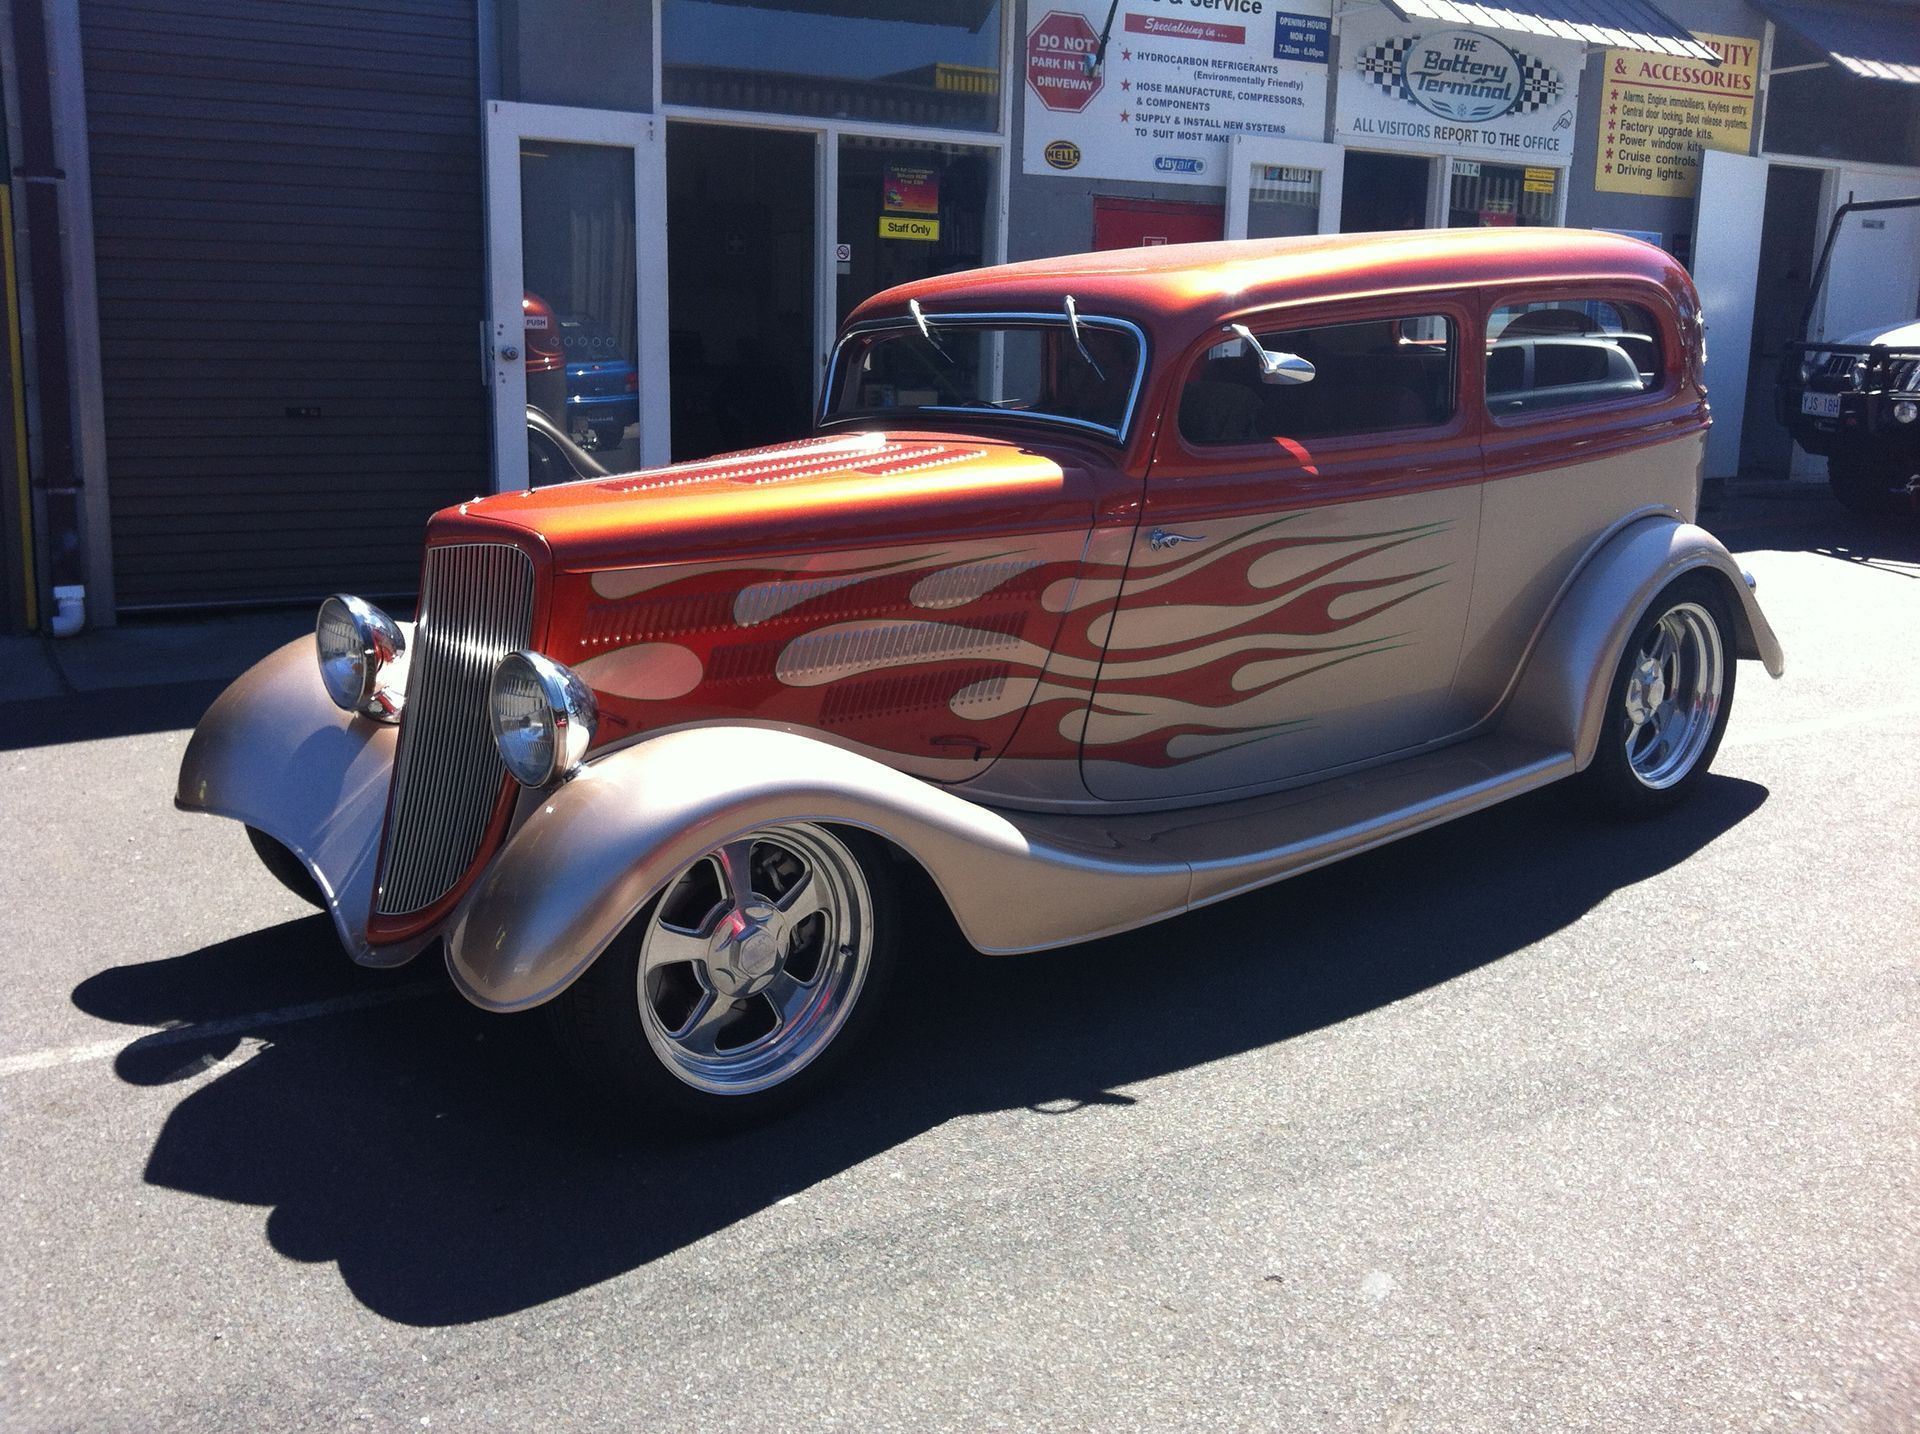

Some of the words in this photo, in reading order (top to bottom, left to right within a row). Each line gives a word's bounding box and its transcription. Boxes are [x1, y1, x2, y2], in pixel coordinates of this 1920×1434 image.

[1144, 18, 1204, 38] Specialising
[1279, 17, 1306, 28] OPENING
[1306, 20, 1327, 31] HOURS
[1039, 34, 1060, 48] DO
[1063, 36, 1094, 52] NOT
[1289, 31, 1304, 41] MON
[1454, 37, 1480, 52] THE
[1031, 56, 1061, 69] PARK
[1063, 60, 1076, 71] IN
[1137, 52, 1209, 68] HYDROCARBON
[1211, 60, 1279, 75] REFRIGERANTS
[1424, 50, 1508, 83] Battery
[1193, 70, 1266, 87] (Environmentally
[1267, 78, 1304, 91] Friendly)
[1614, 57, 1627, 75] &
[1639, 62, 1752, 90] ACCESSORIES
[1037, 76, 1094, 91] DRIVEWAY
[1410, 71, 1512, 101] Terminal
[1136, 82, 1162, 93] HOSE
[1164, 85, 1235, 101] MANUFACTURE,
[1237, 91, 1305, 108] COMPRESSORS,
[1136, 97, 1143, 106] &
[1146, 98, 1210, 111] COMPONENTS
[1648, 93, 1667, 107] Engine
[1707, 101, 1730, 115] Keyless
[1135, 113, 1171, 124] SUPPLY
[1174, 116, 1181, 125] &
[1183, 117, 1221, 128] INSTALL
[1223, 120, 1244, 130] NEW
[1245, 122, 1286, 134] SYSTEMS
[1621, 105, 1643, 118] Central
[1645, 107, 1660, 119] door
[1686, 112, 1700, 124] Boot
[1701, 115, 1722, 127] release
[1135, 128, 1148, 137] TO
[1152, 129, 1174, 139] SUIT
[1177, 131, 1202, 141] MOST
[1353, 117, 1374, 133] ALL
[1378, 120, 1430, 138] VISITORS
[1434, 126, 1479, 143] REPORT
[1482, 131, 1496, 145] TO
[1500, 132, 1520, 147] THE
[1523, 135, 1560, 151] OFFICE
[1620, 119, 1654, 136] Factory
[1657, 126, 1693, 139] upgrade
[1696, 129, 1713, 140] kits.
[1619, 133, 1647, 147] Power
[1651, 138, 1684, 151] window
[1047, 150, 1081, 162] HELLA
[1618, 149, 1651, 163] Cruise
[1655, 154, 1699, 168] controls.
[1617, 163, 1652, 180] Driving
[1656, 166, 1686, 181] lights.
[887, 222, 909, 233] Staff
[911, 223, 931, 236] Only
